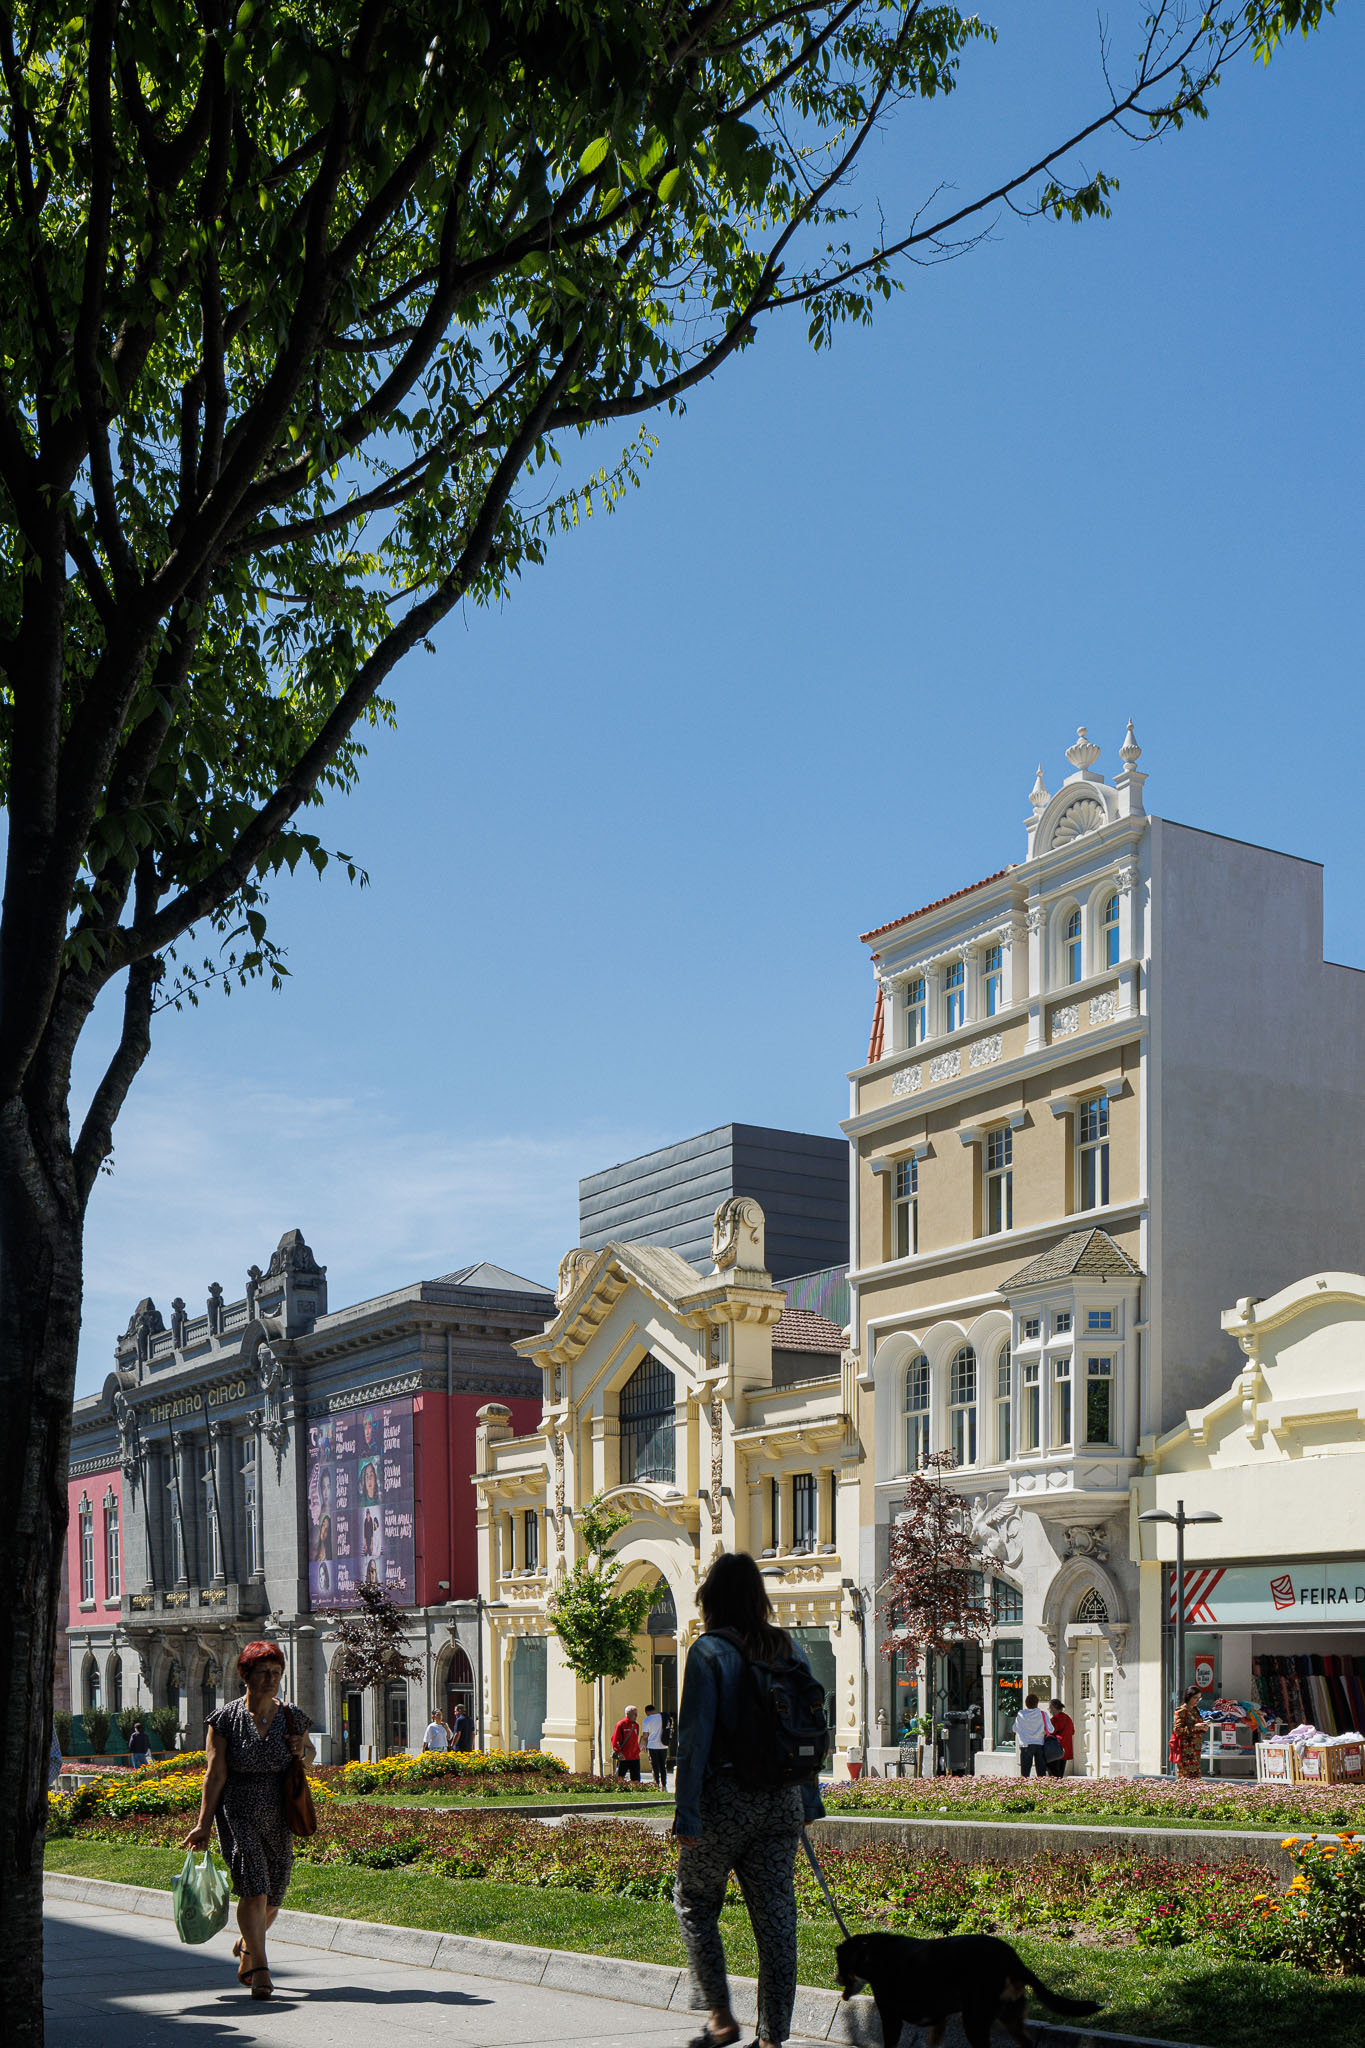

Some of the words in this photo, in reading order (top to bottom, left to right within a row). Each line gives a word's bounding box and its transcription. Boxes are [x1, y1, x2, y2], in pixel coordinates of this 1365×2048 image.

[150, 1394, 202, 1423] THEATRO
[208, 1380, 246, 1406] CIRCO
[1301, 1587, 1349, 1605] FEIRA
